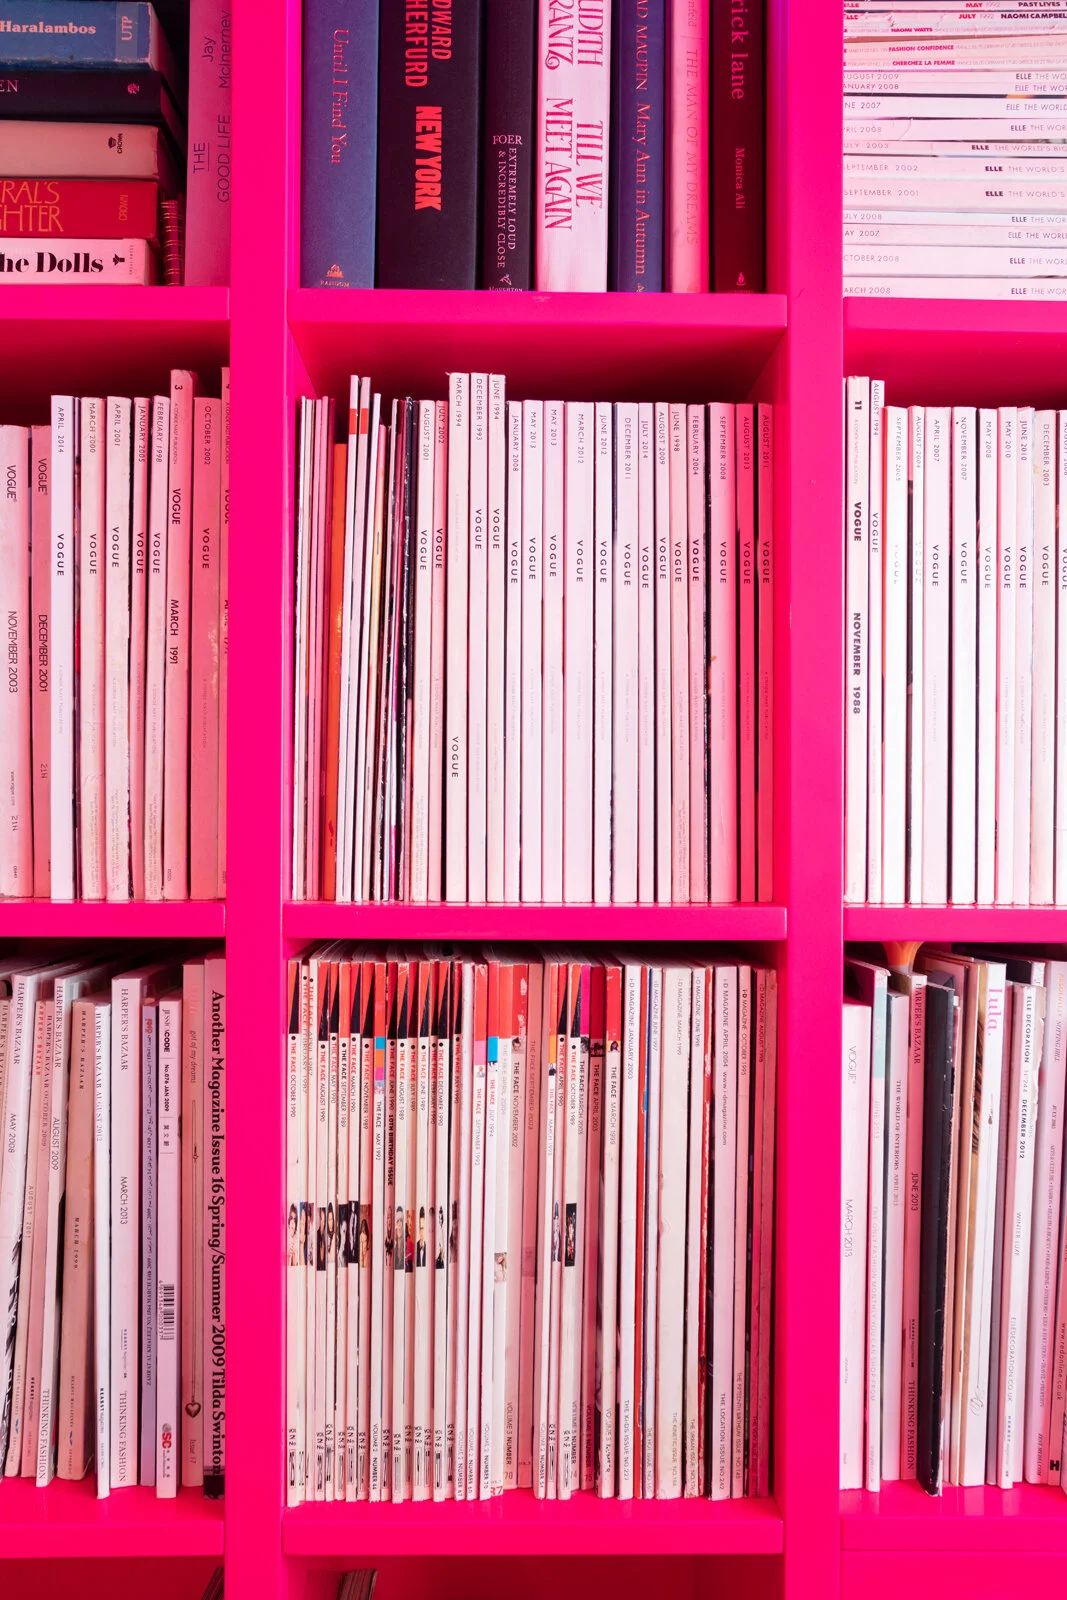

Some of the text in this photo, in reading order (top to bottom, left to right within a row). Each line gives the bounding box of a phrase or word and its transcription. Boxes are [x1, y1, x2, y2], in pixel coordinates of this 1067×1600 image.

[0, 20, 97, 35] Haralambos
[121, 15, 133, 41] UTP
[202, 36, 216, 63] Jay
[218, 9, 233, 89] McInerney
[333, 29, 349, 73] Until
[917, 44, 954, 52] CONFIDENCE
[731, 52, 749, 100] lane
[860, 101, 882, 109] 2007
[331, 90, 349, 129] Find
[492, 134, 523, 145] FOER
[193, 142, 206, 174] THE
[217, 114, 231, 203] GOOD LIFE
[331, 132, 348, 164] You
[415, 105, 442, 211] NEW YORK
[544, 98, 575, 231] MEET AGAIN
[575, 120, 604, 208] TILL WE
[632, 25, 651, 275] MAUPIN Mary Ann in Autumn
[685, 48, 698, 245] THE MAN OF MY DREAMS
[118, 194, 129, 221] CROWN
[507, 147, 517, 250] EXTREMELY LOUD
[735, 147, 746, 209] Monica Ali
[844, 189, 892, 197] SEPTEMBER
[497, 150, 506, 269] & INCREDIBLY CLOSE
[36, 252, 104, 273] Dolls
[1010, 287, 1027, 295] ELLE
[7, 465, 17, 499] VOGUE
[38, 458, 47, 493] VOGUE
[57, 407, 65, 576] APRIL 2014 VOGUE
[201, 405, 211, 569] OCTOBER 2002 VOGUE
[492, 379, 500, 549] JUNE 1994 VOGUE
[871, 382, 880, 553] AUGUST 1994 VOGUE
[718, 415, 727, 584] SEPTEMBER 2008 VOGUE
[854, 501, 862, 542] VOGUE
[1019, 420, 1028, 589] JUNE 2010 VOGUE
[169, 487, 182, 664] VOGUE MARCH 1991
[451, 377, 463, 778] MARCH 1994 VOGUE
[7, 611, 19, 693] NOVEMBER 2003
[38, 614, 48, 693] DECEMBER 2001
[853, 612, 861, 676] NOVEMBER
[853, 686, 861, 714] 1988
[721, 989, 729, 1027] MAGAZINE
[1023, 1013, 1031, 1063] DECORATION
[190, 1061, 198, 1084] dreams
[119, 987, 129, 1225] HARPER'S BAZAAR MARCH 2013
[511, 1095, 519, 1131] NOVEMBER
[911, 1027, 922, 1211] BAZAAR JUNE 2013
[1019, 1099, 1028, 1138] DECEMBER
[511, 1132, 519, 1148] 2002
[843, 1045, 857, 1257] VOGUE MARCH 2013
[1018, 1140, 1026, 1159] 2012
[208, 989, 225, 1475] Another Magazine Issue 16 Spring/Summer 2009 Tilda Swinton
[117, 1391, 127, 1482] THINKING FASHION
[906, 1380, 915, 1470] THINKING FASHION
